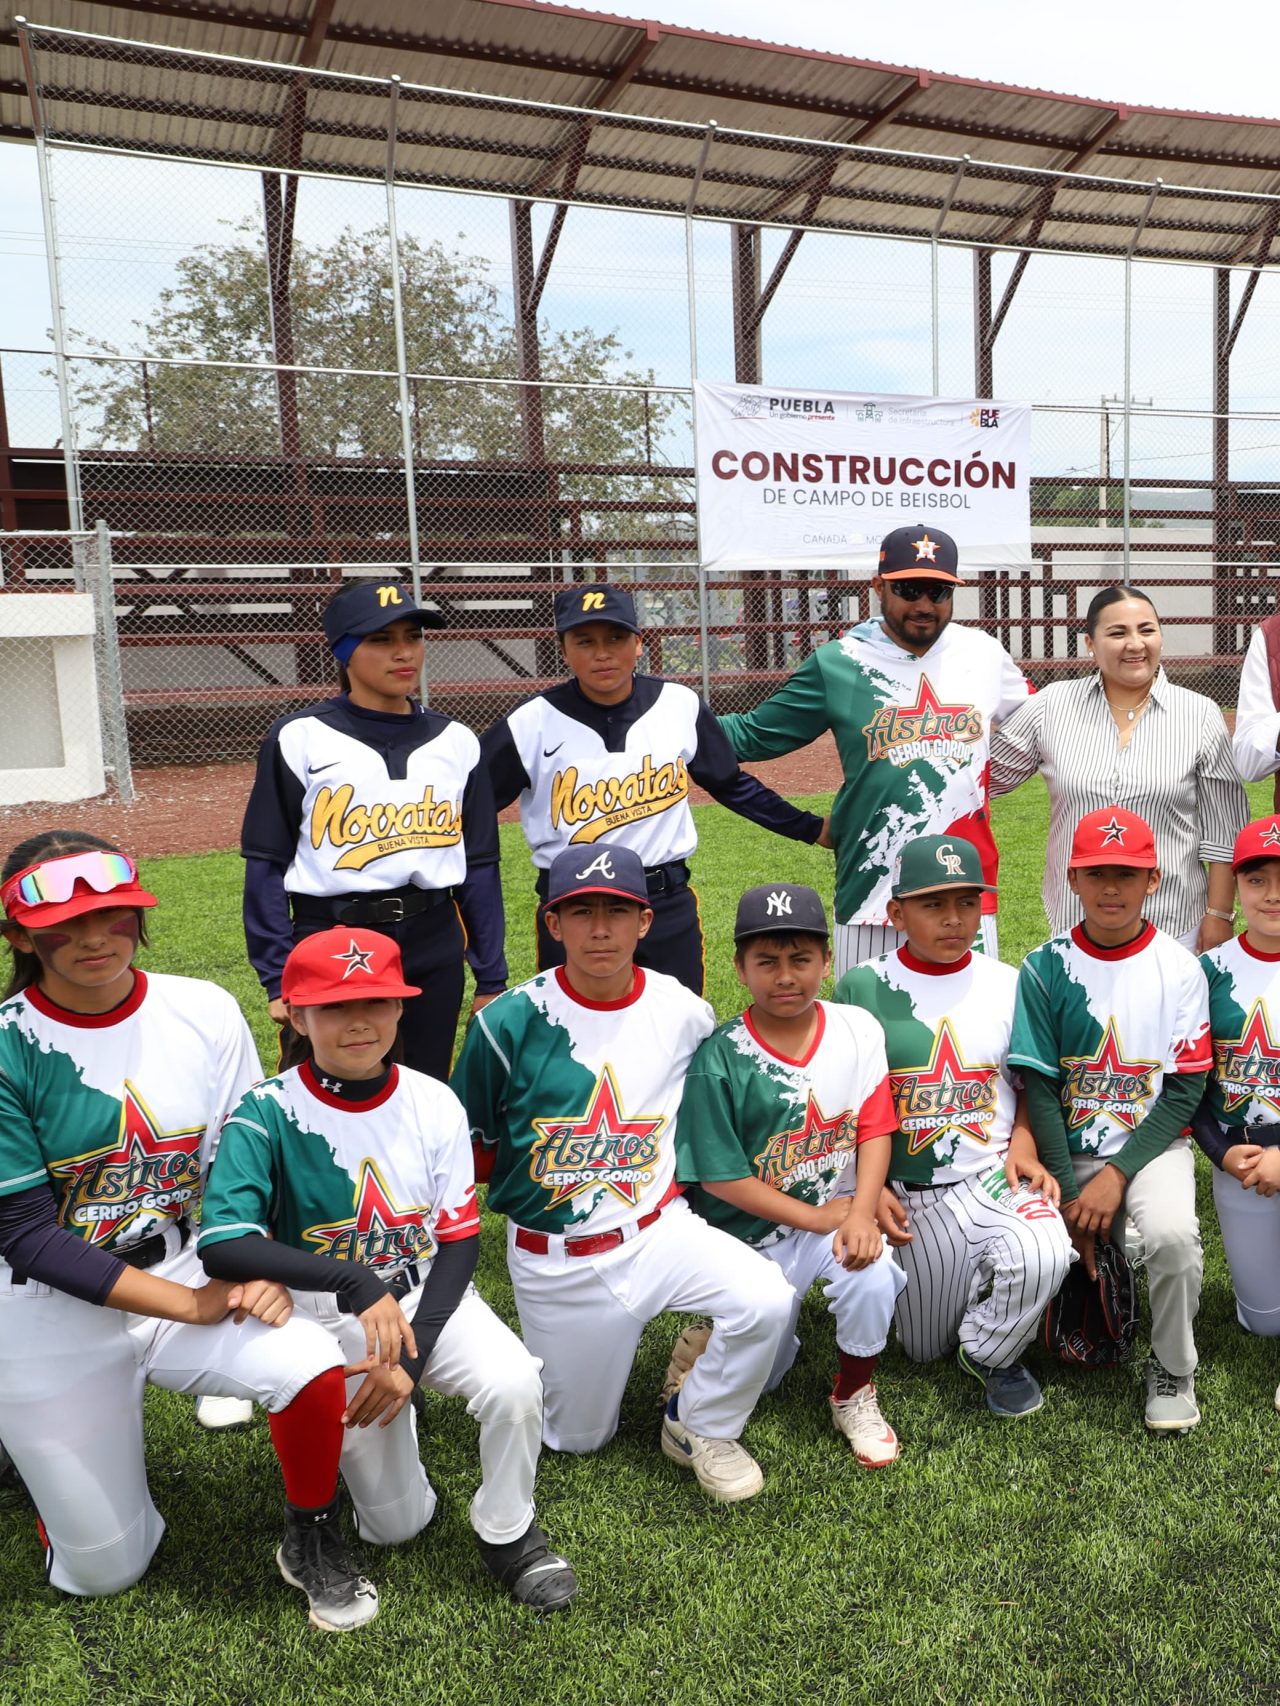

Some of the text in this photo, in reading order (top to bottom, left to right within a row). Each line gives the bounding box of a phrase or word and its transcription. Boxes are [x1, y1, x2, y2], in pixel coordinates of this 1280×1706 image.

[769, 398, 835, 414] PUEBLA
[808, 413, 835, 421] presente
[711, 450, 1016, 489] CONSTRUCCIÓN
[763, 488, 971, 509] DE CAMPO DE BEISBOL
[864, 706, 981, 760] Astros
[888, 739, 971, 766] CERRO GORDO
[605, 804, 652, 827] BUENA VISTA
[378, 835, 430, 853] BUENA VISTA
[576, 850, 616, 880] A
[766, 890, 793, 918] NY
[902, 1111, 993, 1131] CERRO GORDO
[535, 1126, 658, 1178] Astros
[598, 1168, 652, 1184] GORDO
[74, 1199, 140, 1223] CERRO
